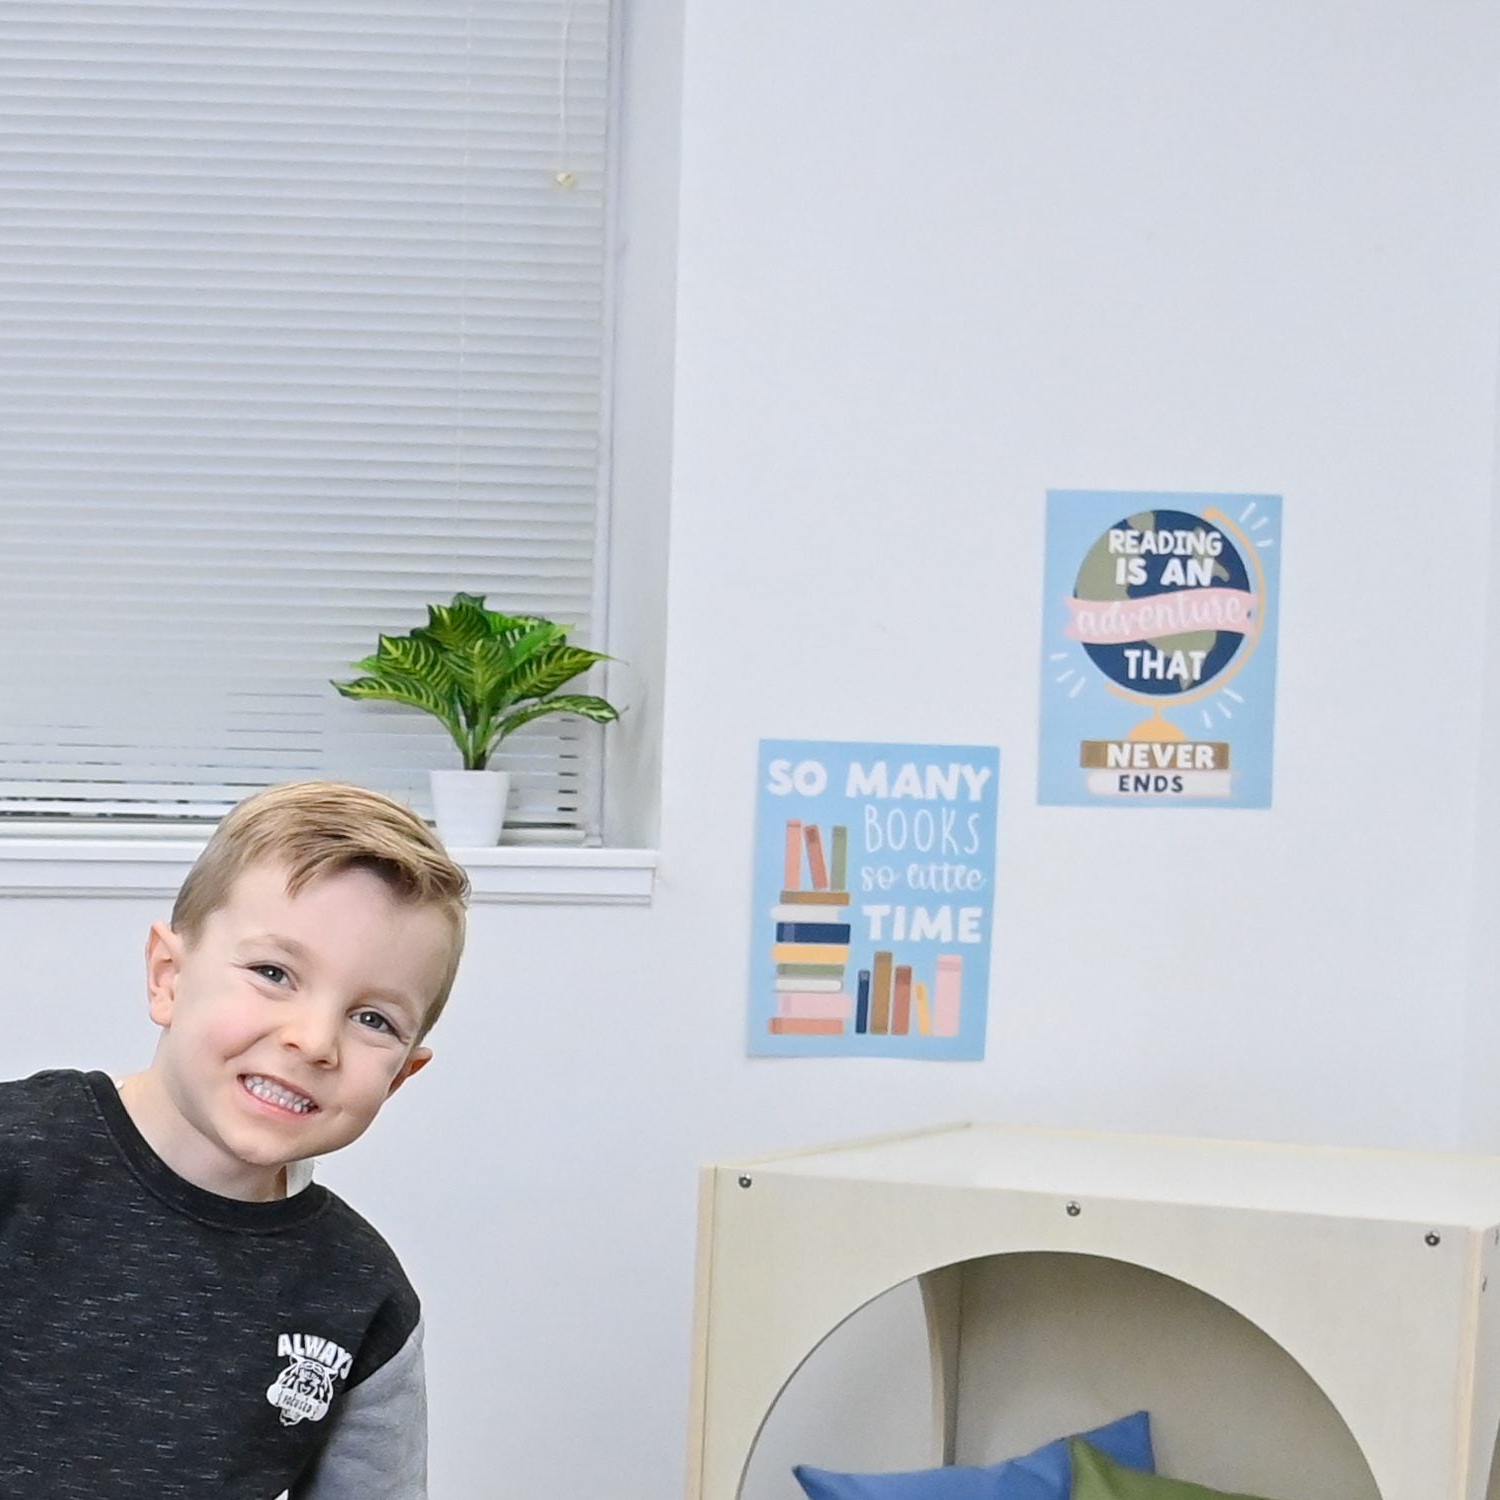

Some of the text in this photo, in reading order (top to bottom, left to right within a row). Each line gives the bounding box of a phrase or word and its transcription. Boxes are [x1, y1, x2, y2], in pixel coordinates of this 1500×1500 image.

[1108, 528, 1223, 557] READING
[1115, 557, 1214, 587] IS AN
[1075, 594, 1244, 635] adventure
[1124, 649, 1206, 681] THAT
[1106, 743, 1216, 770] NEVER
[767, 758, 992, 801] SO MANY
[1118, 774, 1184, 793] ENDS
[864, 804, 981, 855] BOOKS
[861, 862, 987, 892] so little
[861, 904, 983, 943] TIME
